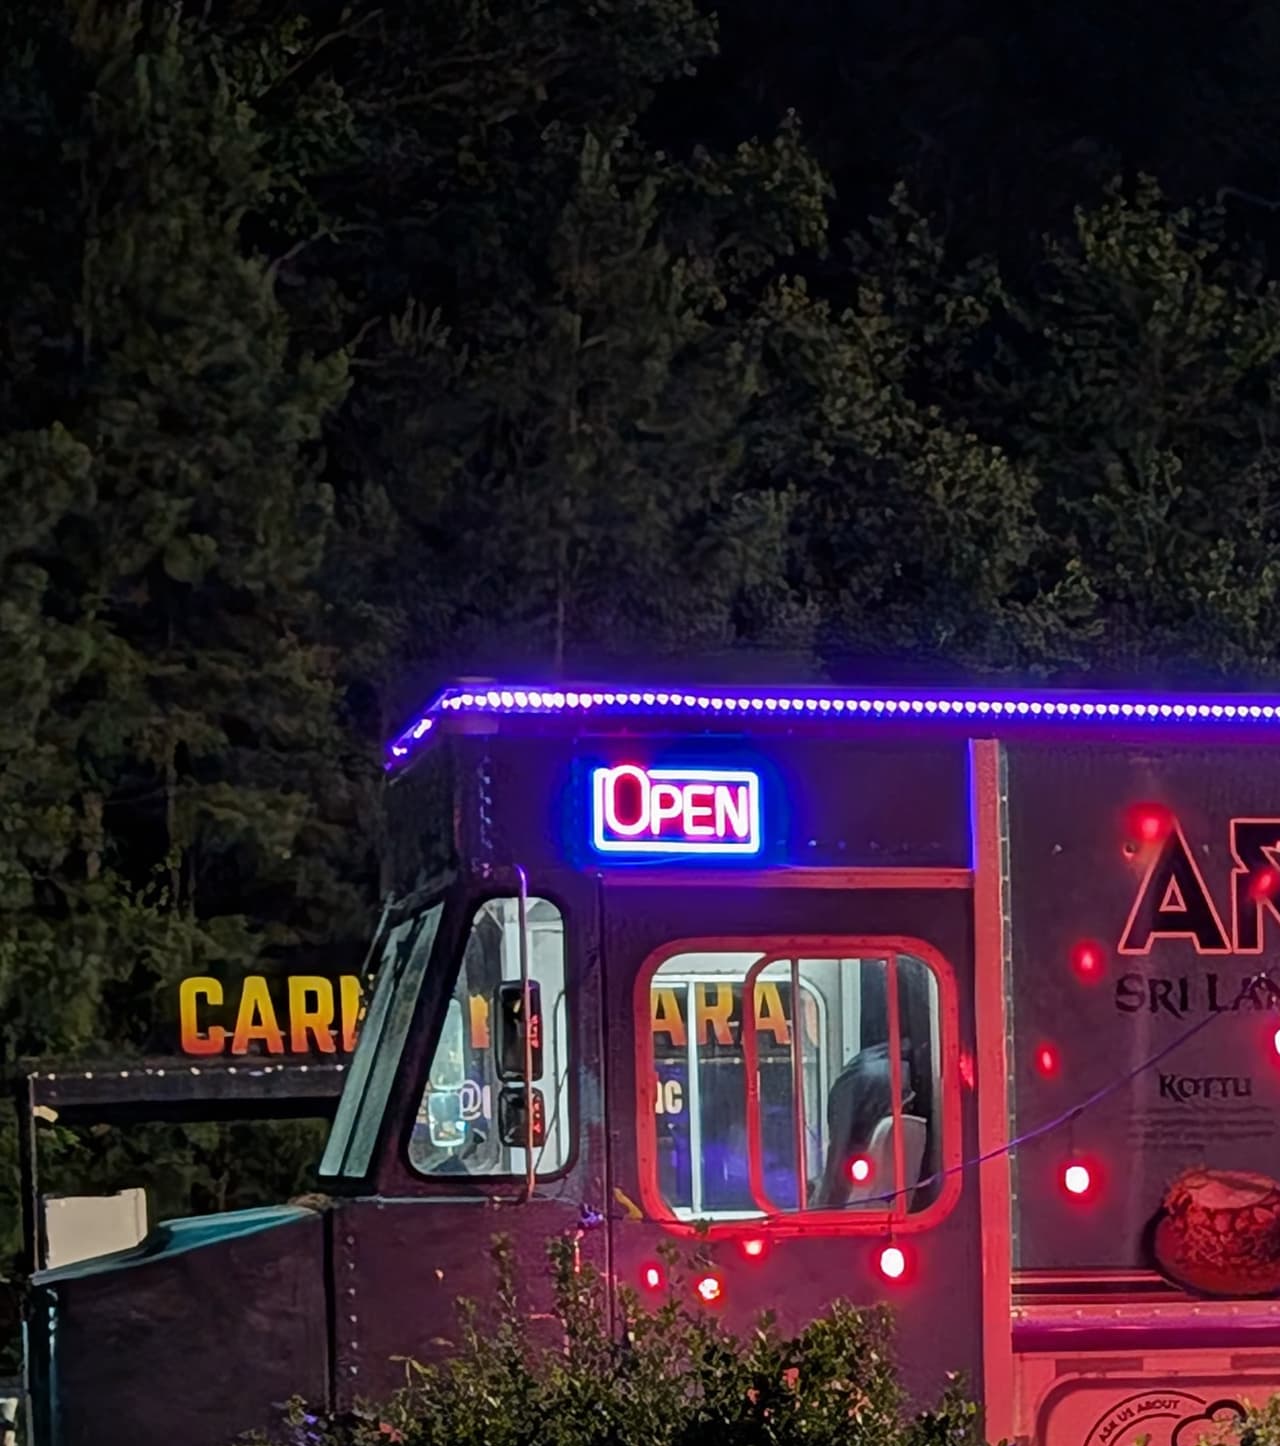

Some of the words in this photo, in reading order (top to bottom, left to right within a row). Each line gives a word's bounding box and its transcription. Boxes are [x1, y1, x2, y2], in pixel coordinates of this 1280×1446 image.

[604, 765, 749, 838] OPEN
[1115, 973, 1189, 1018] SRI
[1159, 1072, 1252, 1102] KOTTU
